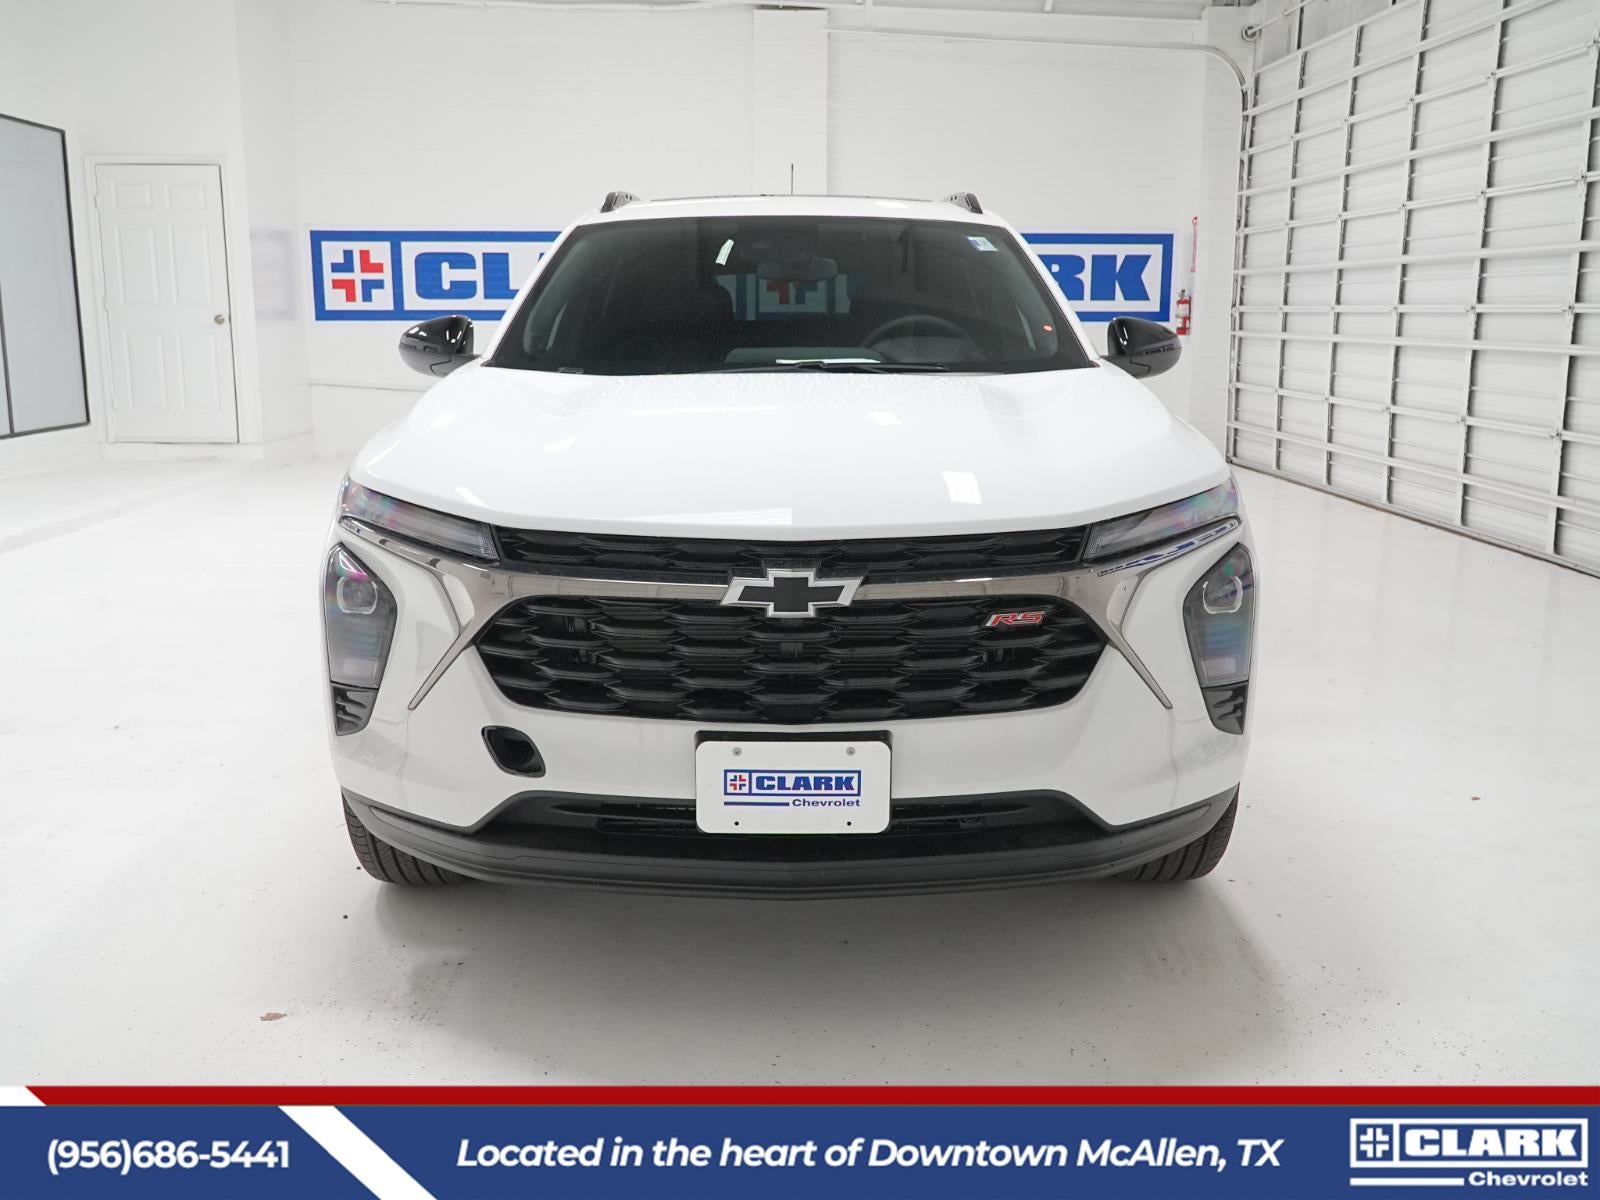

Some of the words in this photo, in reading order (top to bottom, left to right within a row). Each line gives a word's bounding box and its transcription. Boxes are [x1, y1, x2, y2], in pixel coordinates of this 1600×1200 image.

[984, 610, 1046, 628] RS
[755, 776, 855, 791] CLARK
[791, 798, 860, 807] Chevrolet
